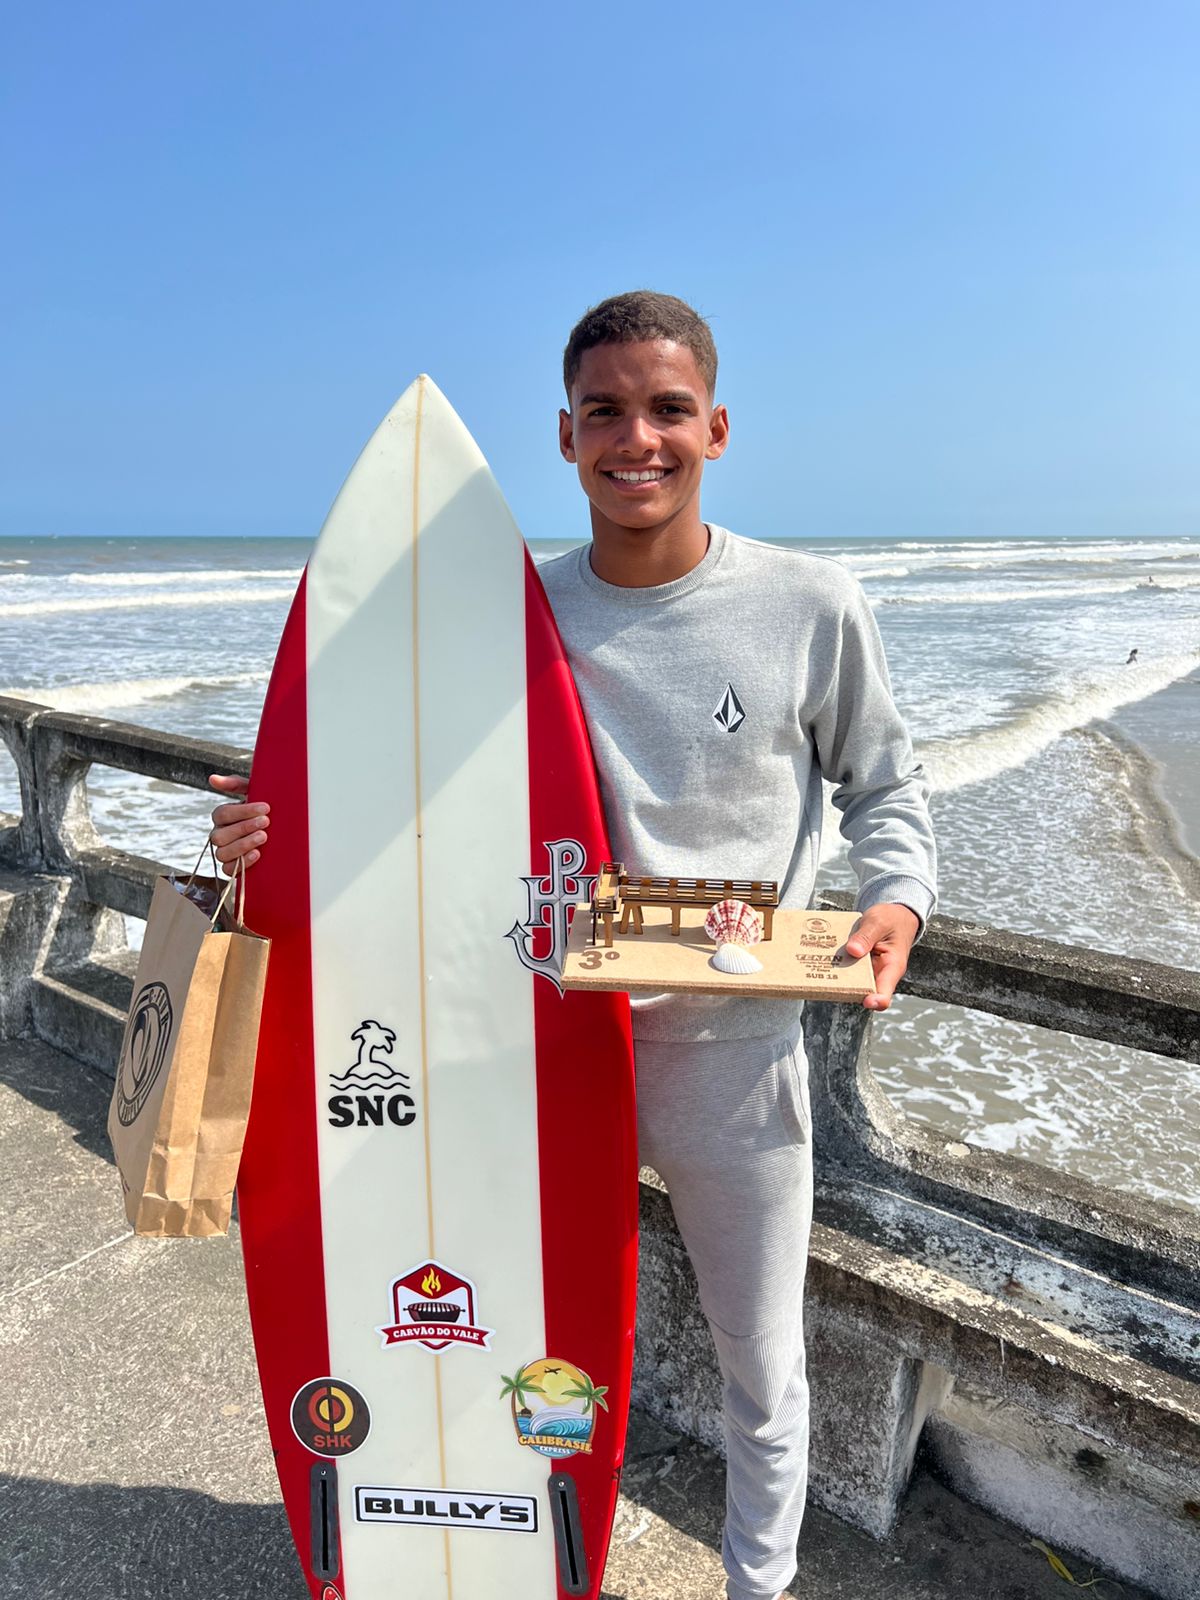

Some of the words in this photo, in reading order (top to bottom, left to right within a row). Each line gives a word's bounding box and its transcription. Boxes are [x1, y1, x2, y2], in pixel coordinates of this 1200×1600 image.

[328, 1094, 416, 1127] SNC
[393, 1326, 435, 1338] CARVÃO
[437, 1327, 451, 1336] DO
[452, 1328, 480, 1340] VALE
[313, 1434, 352, 1448] SHK
[519, 1435, 592, 1452] CALIBRASIL
[364, 1497, 529, 1523] BULLY'S
